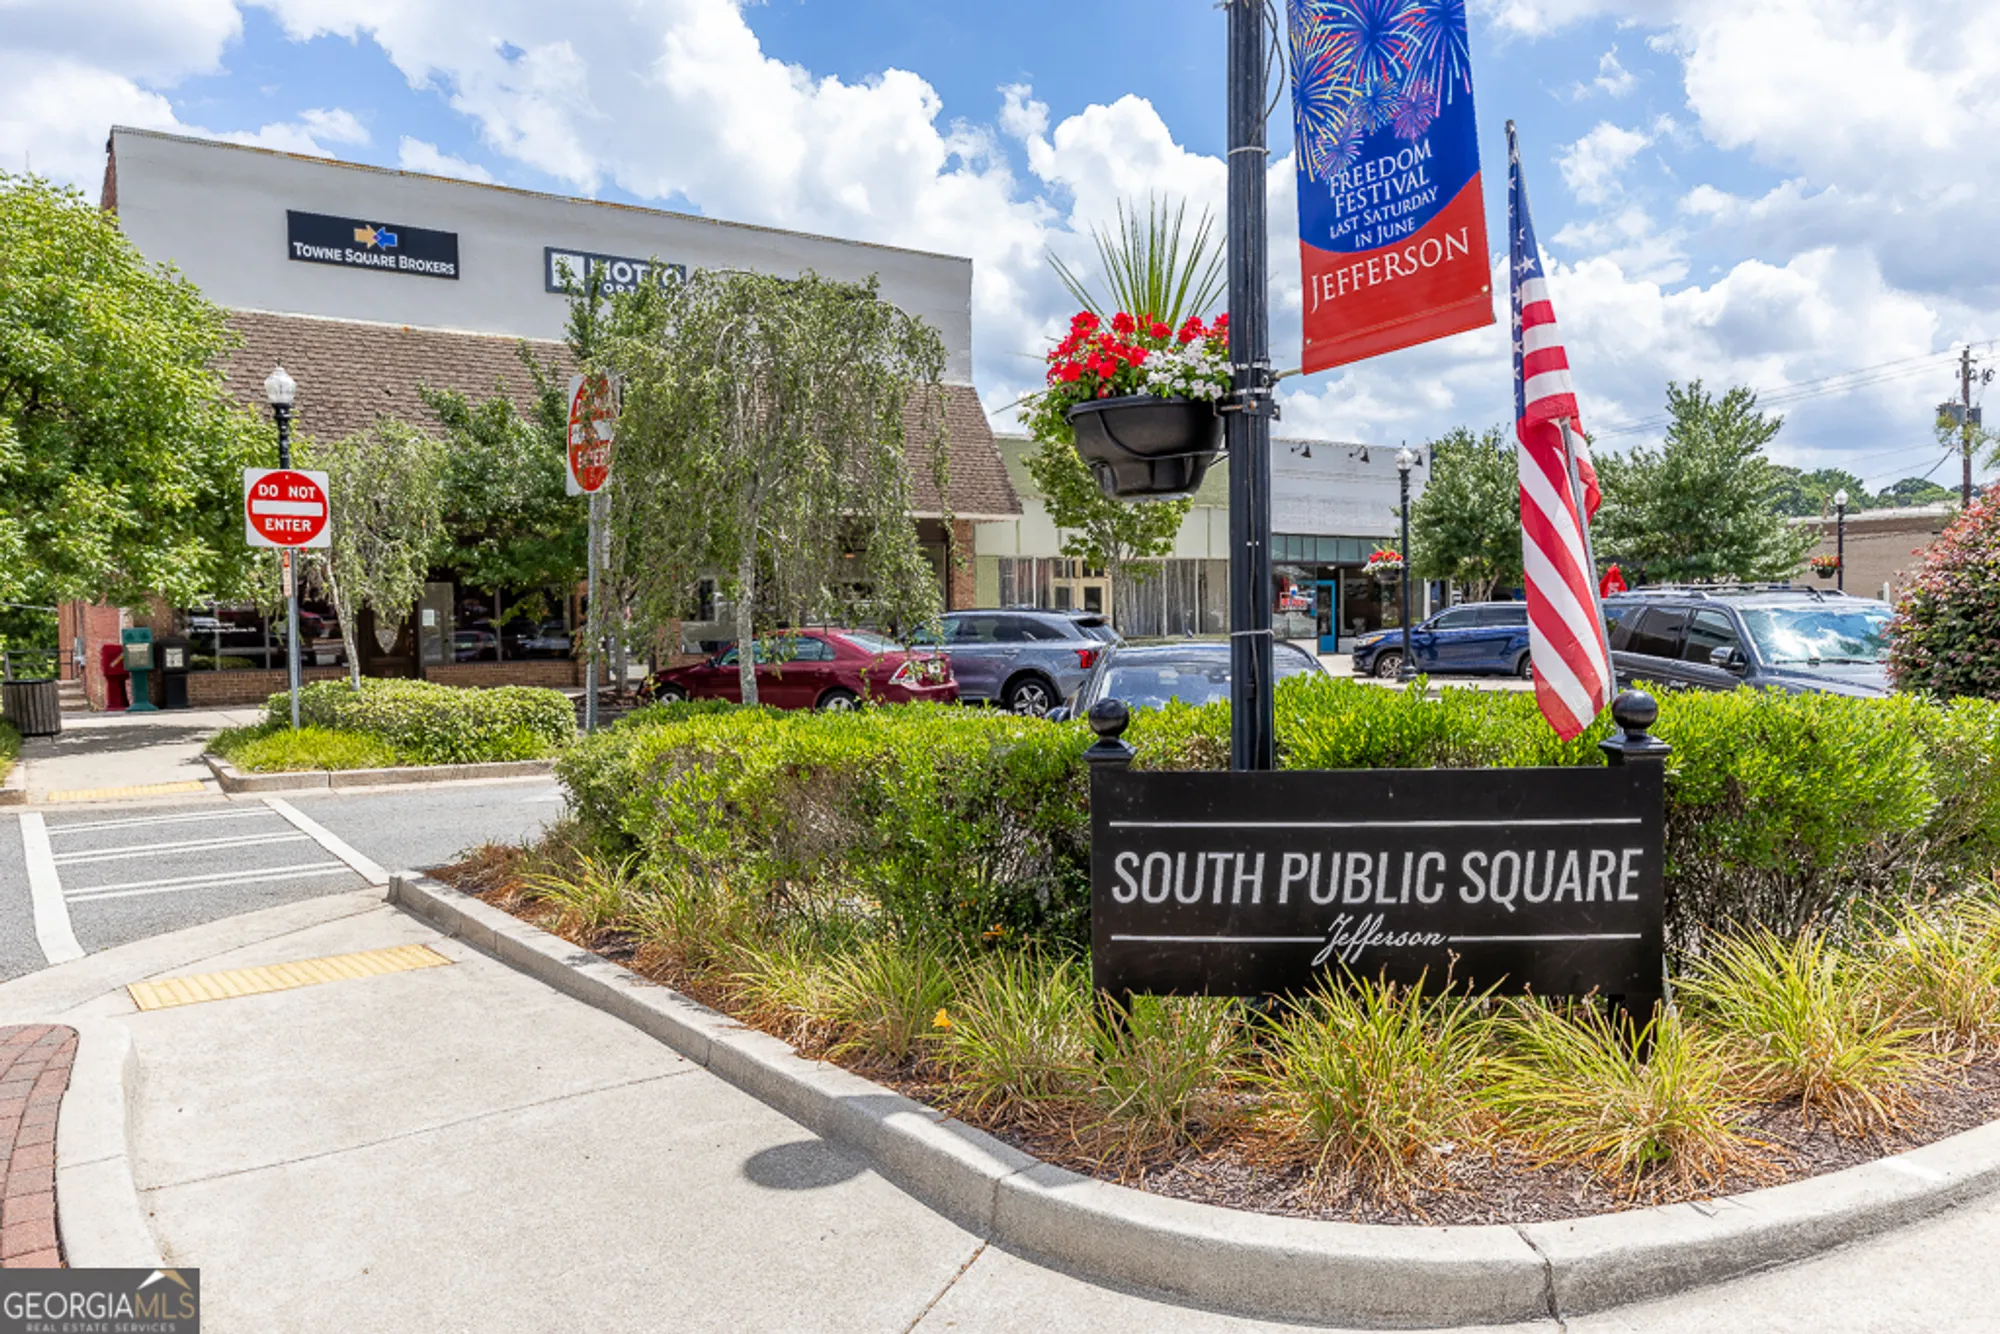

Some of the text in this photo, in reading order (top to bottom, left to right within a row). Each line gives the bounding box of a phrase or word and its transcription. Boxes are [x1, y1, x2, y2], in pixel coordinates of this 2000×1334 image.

[1329, 138, 1433, 198] FREEDOM
[1335, 165, 1431, 218] FESTIVAL
[1329, 185, 1439, 239] LAST SATURDAY
[1355, 217, 1416, 248] IN JUNE
[293, 242, 456, 275] TOWNE SQUARE BROKERS
[1310, 226, 1470, 314] JEFFERSON
[258, 484, 316, 499] DO NOT
[264, 518, 312, 532] ENTER
[1112, 848, 1644, 912] SOUTH PUBLIC SQUARE
[1311, 912, 1447, 966] Jefferson
